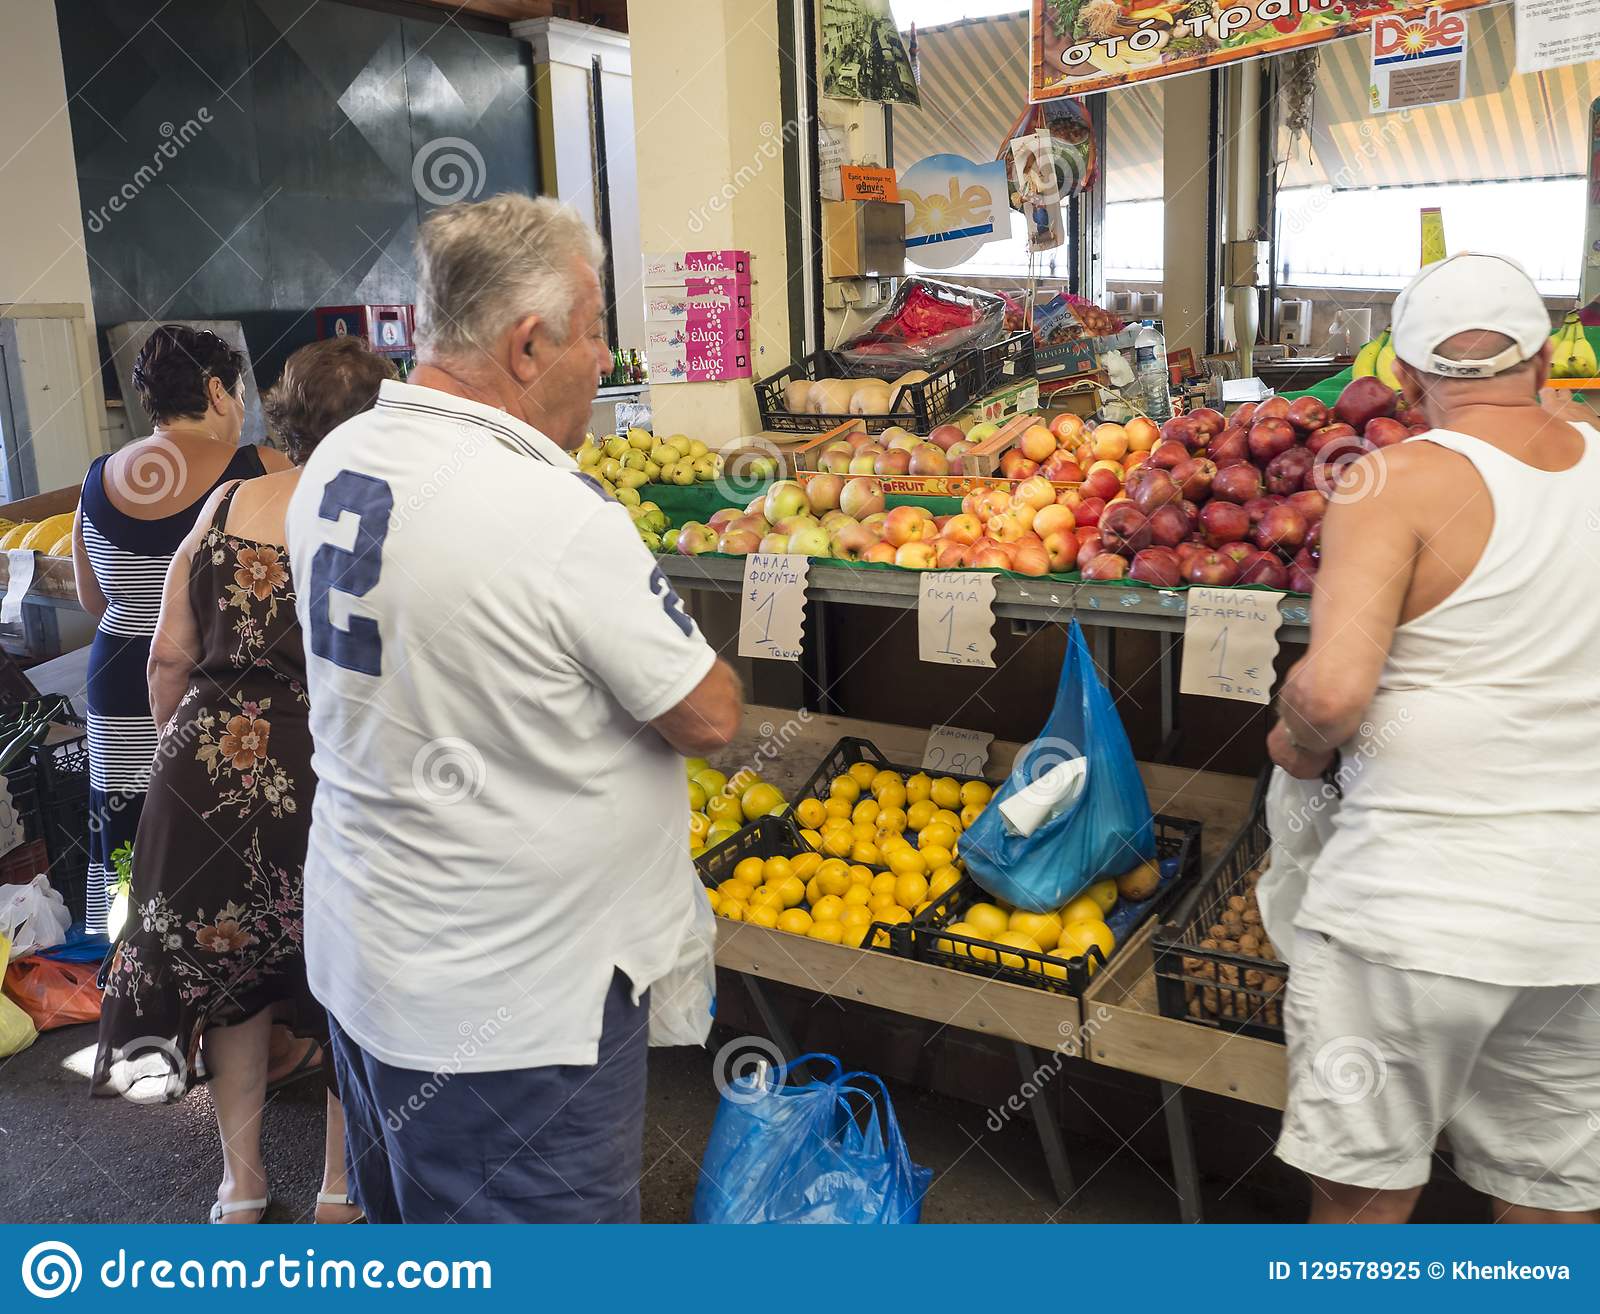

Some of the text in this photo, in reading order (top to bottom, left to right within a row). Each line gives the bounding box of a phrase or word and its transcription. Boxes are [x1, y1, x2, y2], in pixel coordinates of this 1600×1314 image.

[1061, 19, 1160, 66] στό
[1375, 10, 1465, 56] Dole
[310, 469, 394, 677] 2
[650, 565, 693, 638] 2
